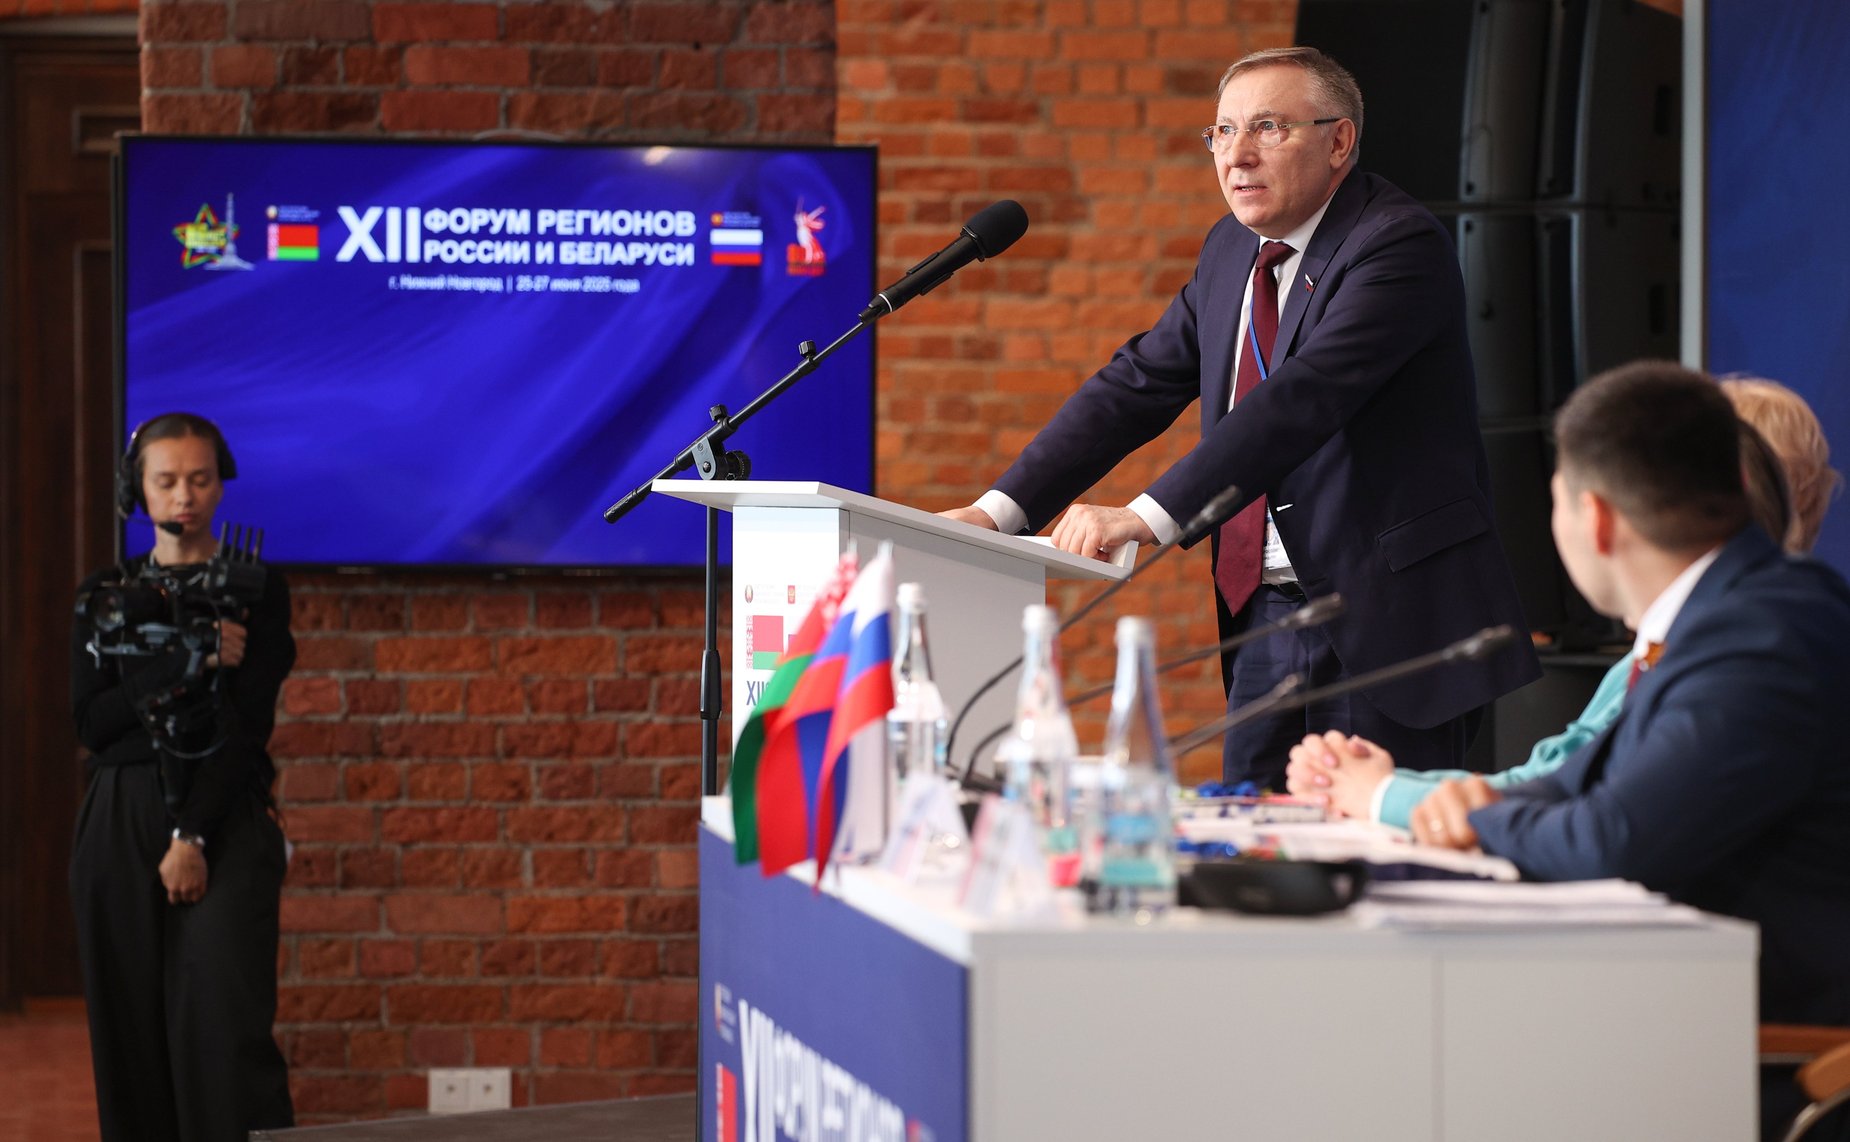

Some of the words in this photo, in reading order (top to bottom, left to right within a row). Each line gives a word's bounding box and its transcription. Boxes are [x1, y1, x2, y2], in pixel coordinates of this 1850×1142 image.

[336, 205, 420, 263] XII
[423, 207, 531, 235] ФОРУМ
[537, 208, 696, 237] РЕГИОНОВ
[423, 239, 531, 265] РОССИИ
[535, 240, 555, 265] И
[559, 241, 695, 266] БЕЛАРУСИ
